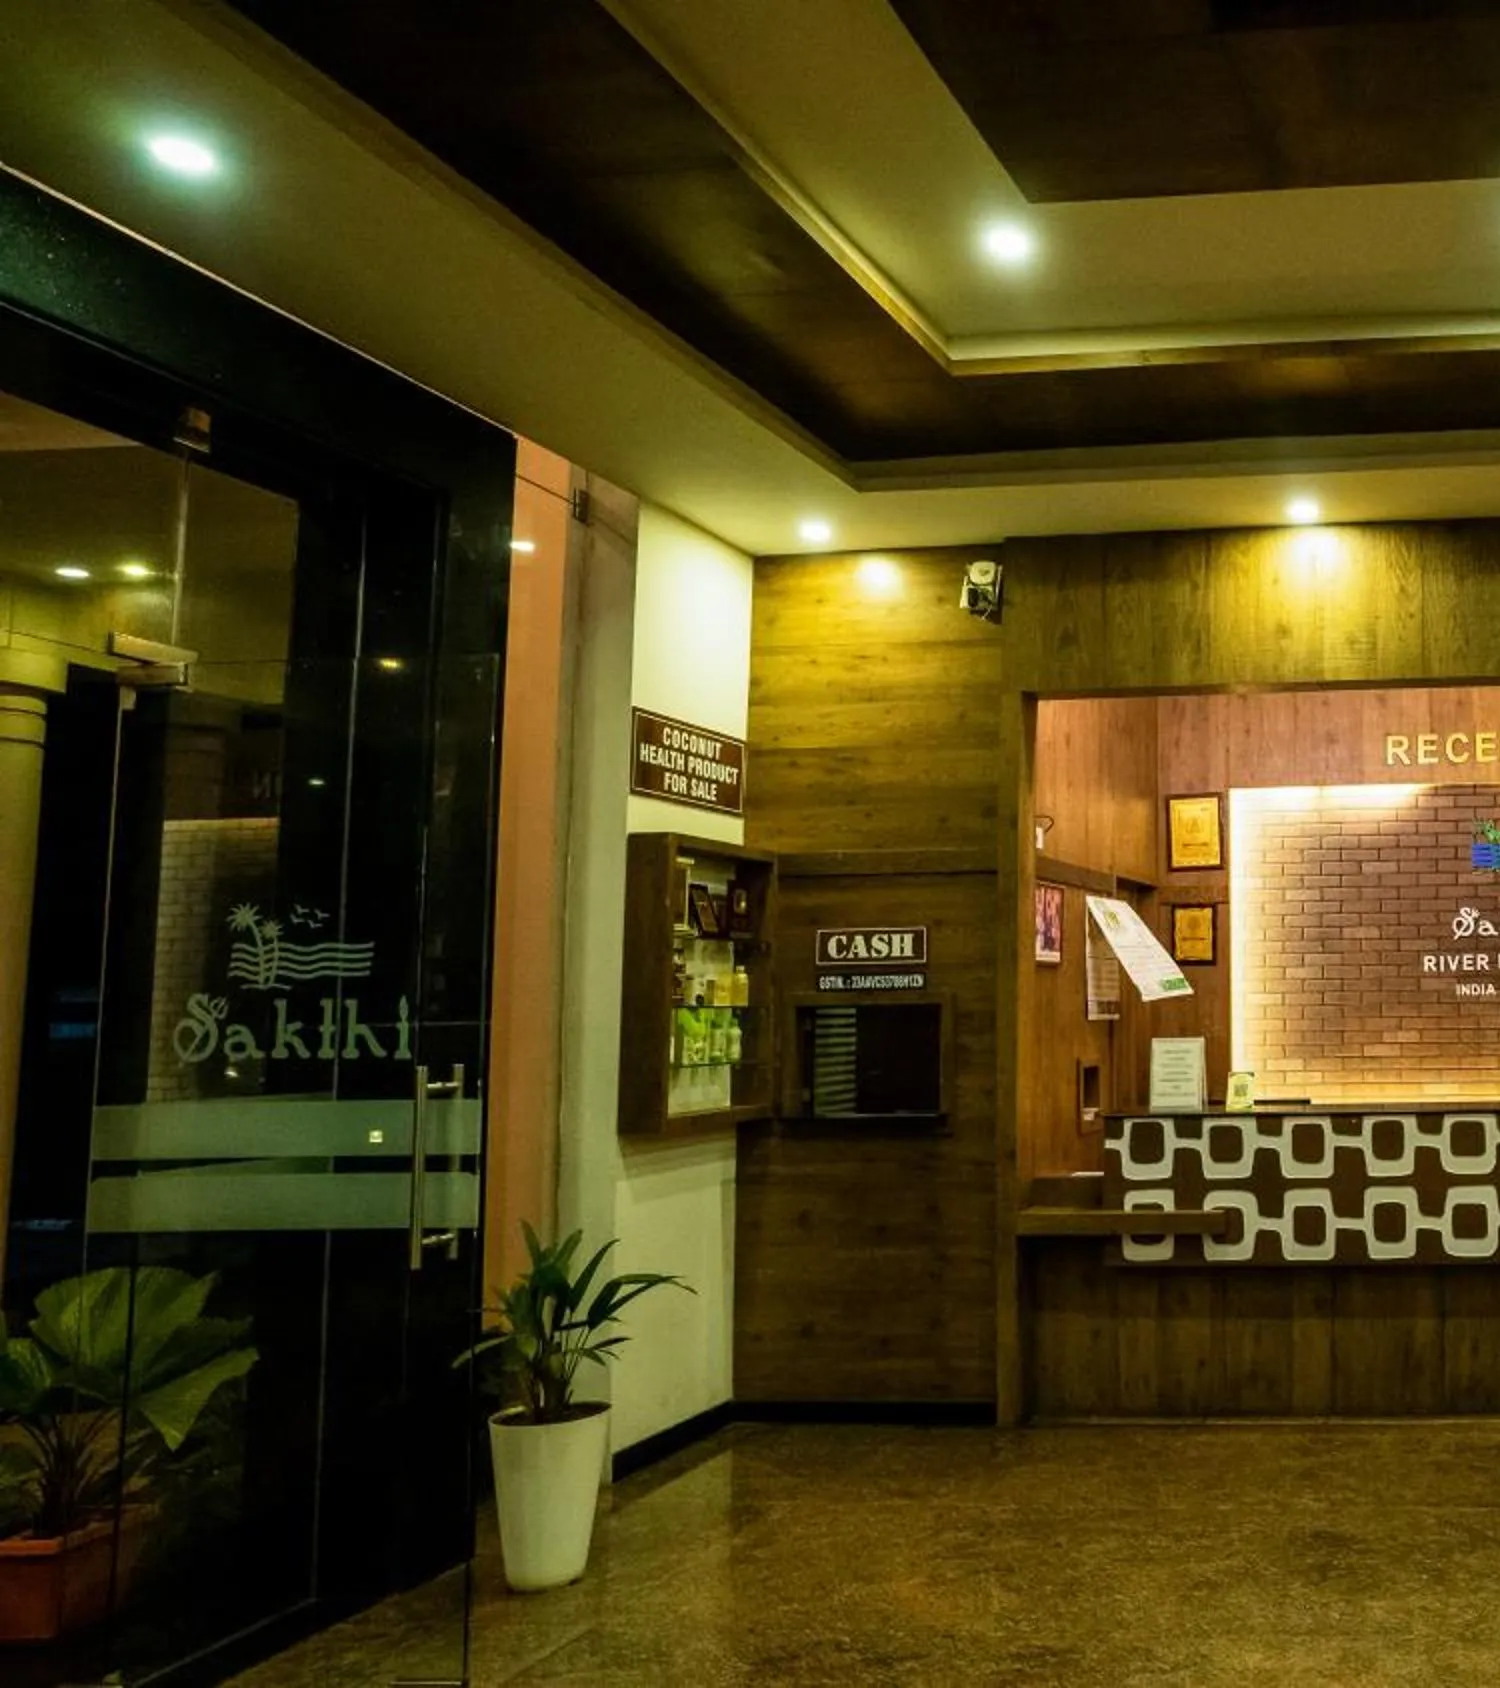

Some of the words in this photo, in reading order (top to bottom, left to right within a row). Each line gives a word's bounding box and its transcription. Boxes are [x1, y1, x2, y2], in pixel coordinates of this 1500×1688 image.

[663, 727, 722, 760] COCONUT
[640, 742, 685, 771] HEALTH
[688, 756, 739, 785] PRODUCT
[664, 772, 687, 794] FOR
[690, 778, 718, 800] SALE
[827, 933, 914, 959] CASH
[1423, 953, 1490, 972] RIVER
[1456, 983, 1496, 996] INDIA
[173, 993, 413, 1067] Sakthi
